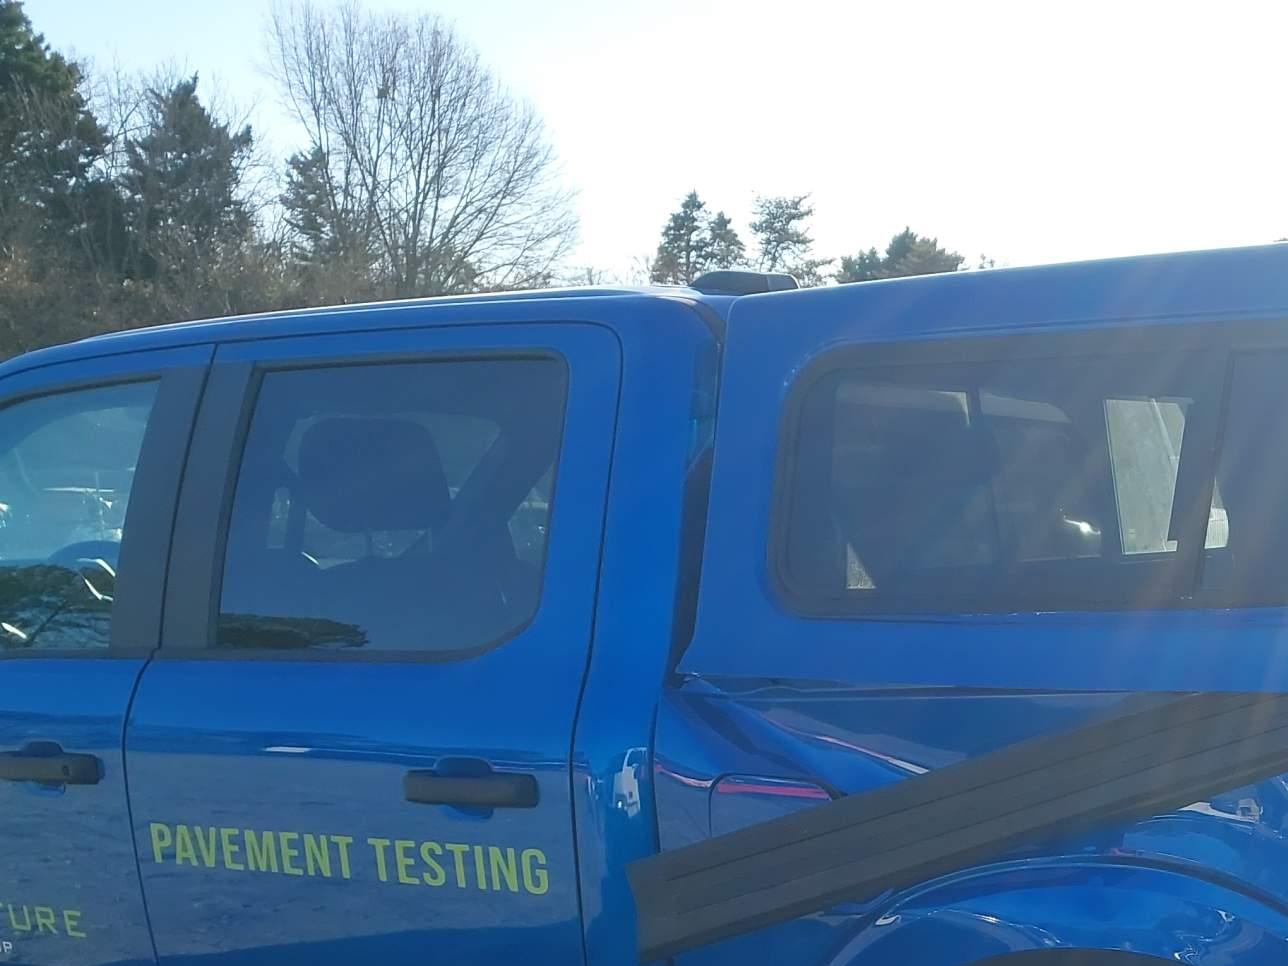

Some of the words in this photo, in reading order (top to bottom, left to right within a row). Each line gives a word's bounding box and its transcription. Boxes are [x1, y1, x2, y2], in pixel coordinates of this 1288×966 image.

[150, 823, 353, 879] PAVEMENT
[367, 837, 550, 895] TESTING
[0, 903, 87, 938] URE
